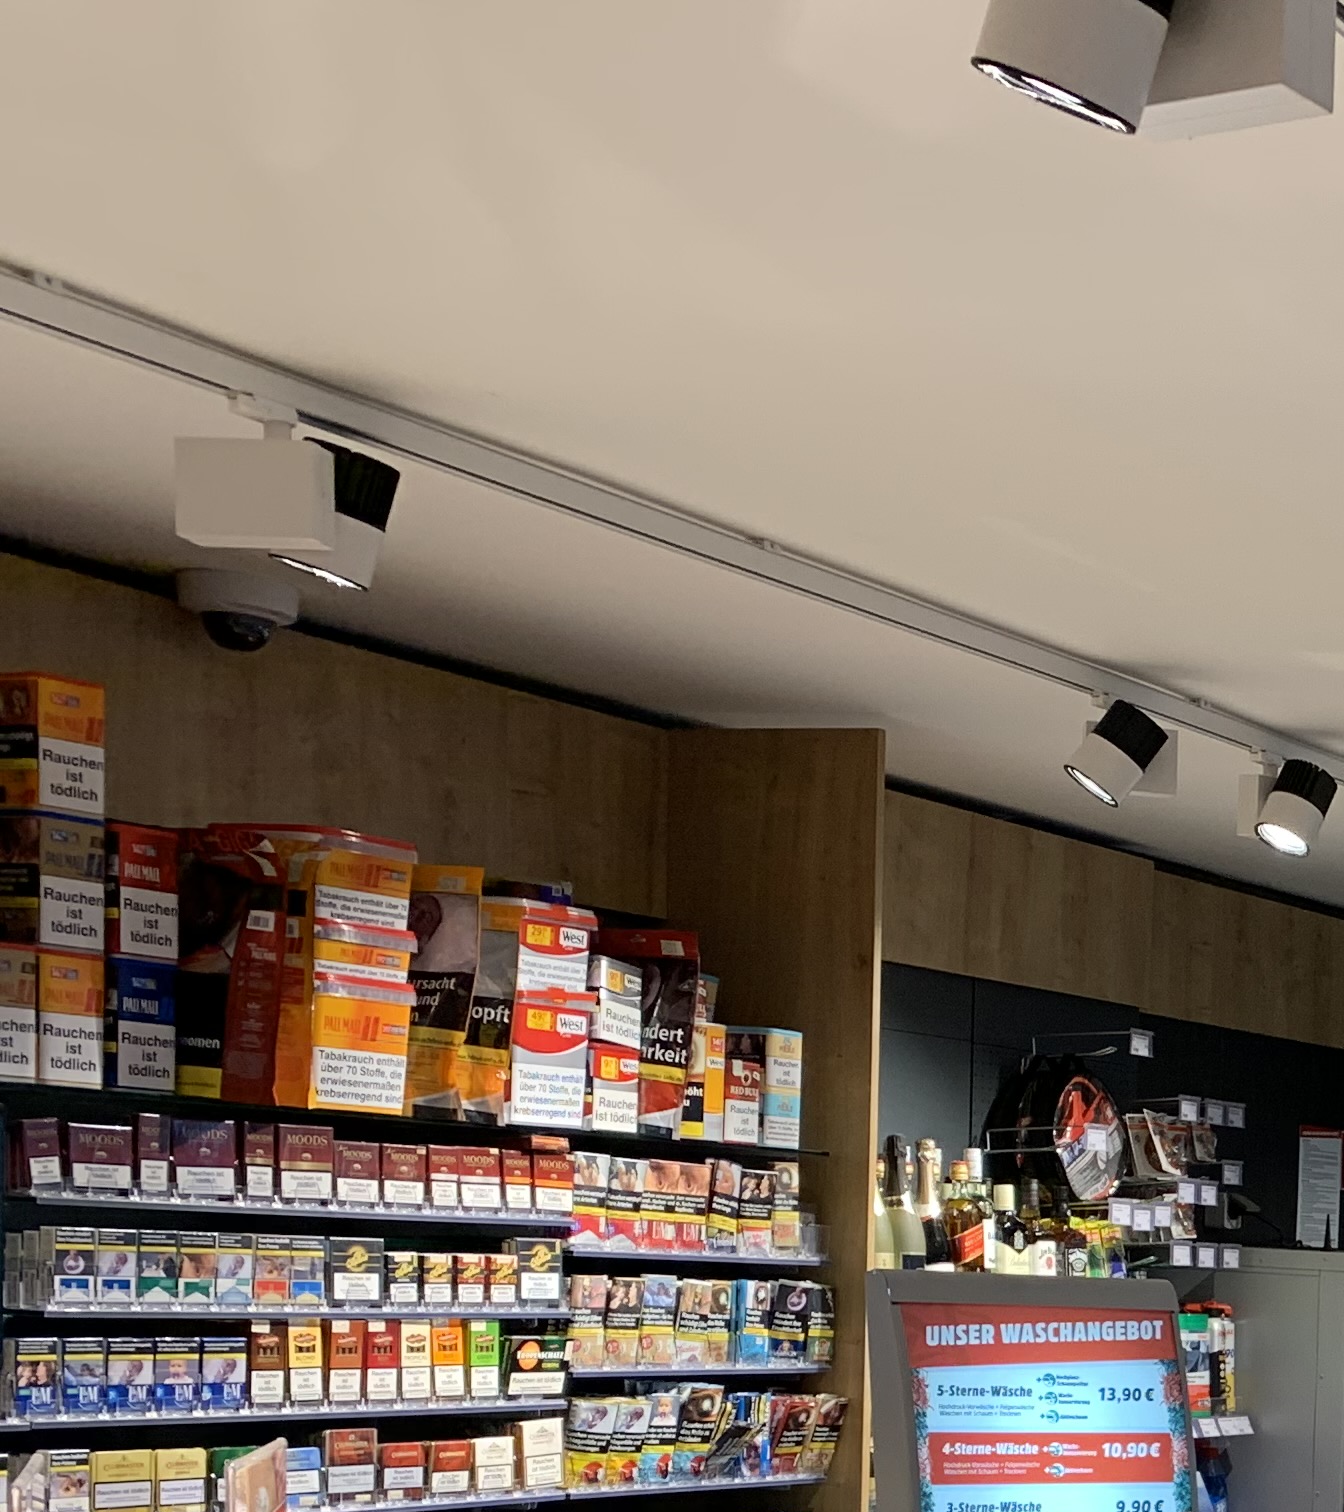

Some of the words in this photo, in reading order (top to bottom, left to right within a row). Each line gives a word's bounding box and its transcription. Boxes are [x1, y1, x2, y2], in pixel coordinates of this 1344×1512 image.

[66, 769, 83, 783] ist
[50, 783, 98, 801] tödlich
[66, 907, 82, 919] ist
[124, 898, 178, 917] Rauchen
[51, 920, 97, 938] tödlich
[144, 917, 158, 929] ist
[131, 931, 172, 947] tödlich
[563, 931, 584, 945] West
[559, 1017, 583, 1032] West
[66, 1042, 81, 1054] ist
[142, 1050, 157, 1062] ist
[51, 1057, 96, 1072] tödlich
[129, 1064, 170, 1079] tödlich
[287, 1135, 327, 1147] MOODS
[539, 1160, 569, 1170] MOODS
[926, 1325, 994, 1346] UNSER
[1000, 1321, 1163, 1344] WASCHANGEBOT
[937, 1385, 1032, 1397] 5-Sterne-Wäsche
[1098, 1388, 1142, 1403] 13,90
[1145, 1388, 1154, 1401] €
[942, 1442, 1038, 1456] 4-Sterne-Wäsche
[1102, 1443, 1147, 1459] 10,90
[1150, 1443, 1160, 1457] €
[1155, 1500, 1164, 1512] €
